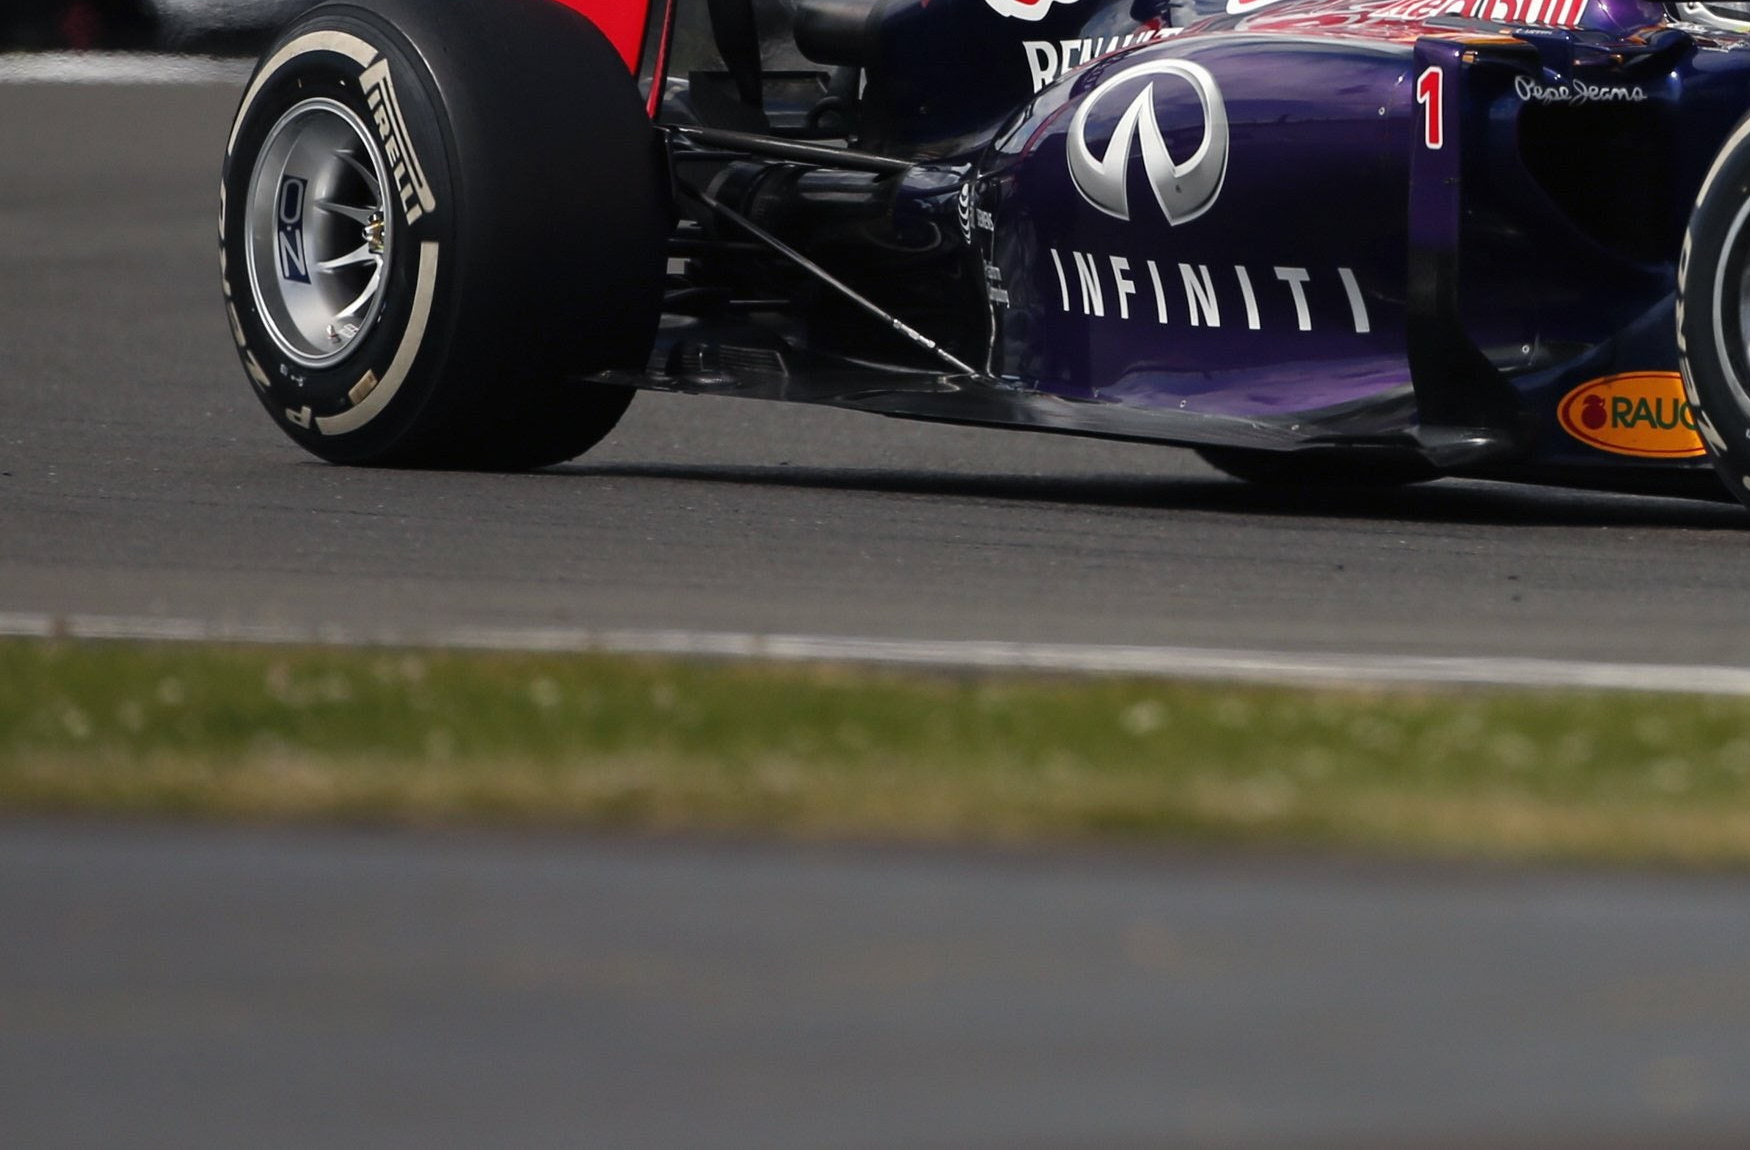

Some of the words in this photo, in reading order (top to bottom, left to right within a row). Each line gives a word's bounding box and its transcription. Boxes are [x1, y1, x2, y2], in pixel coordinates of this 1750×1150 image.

[1417, 66, 1443, 149] 1
[1515, 76, 1572, 105] Pepe
[1569, 79, 1647, 106] Jeans
[359, 58, 436, 226] PIRELLI
[1050, 247, 1370, 334] INFINITI
[1611, 395, 1698, 430] RAUC
